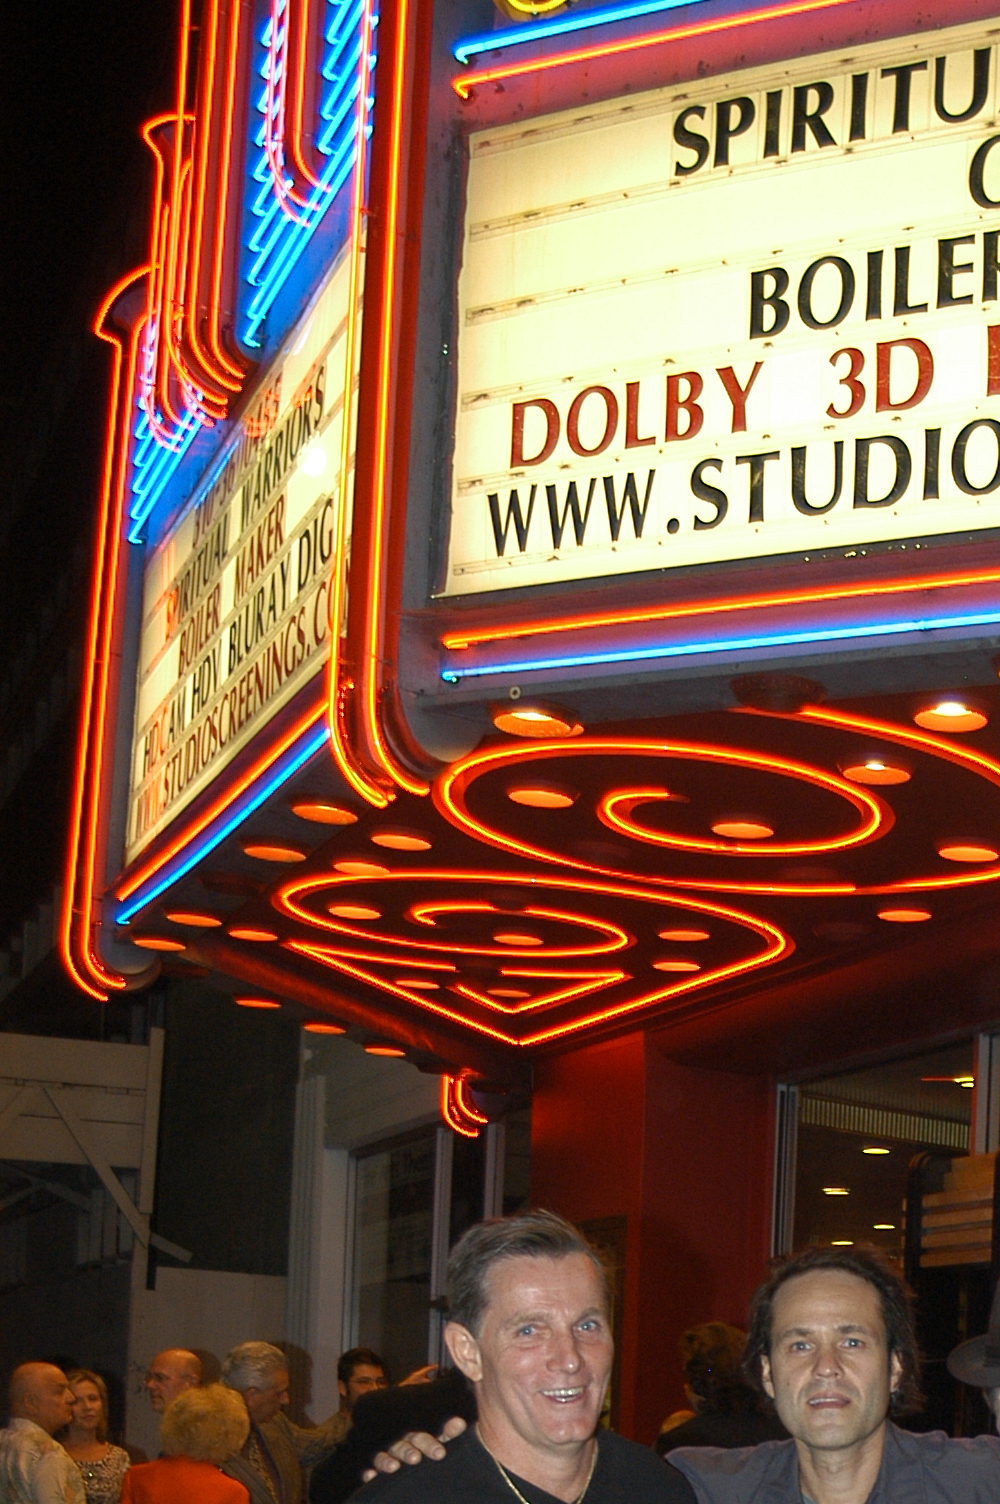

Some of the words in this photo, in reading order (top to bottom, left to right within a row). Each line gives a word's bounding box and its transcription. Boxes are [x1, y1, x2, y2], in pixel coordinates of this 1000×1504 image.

[241, 365, 325, 533] WARRIORS
[510, 361, 764, 468] DOLBY
[826, 337, 934, 419] 3D
[143, 685, 187, 779] HDCAM
[193, 638, 222, 719] HDV
[229, 552, 290, 675] BLURAY
[298, 498, 334, 592] DIG
[178, 583, 221, 678] BOILER
[234, 494, 284, 607] MAKER
